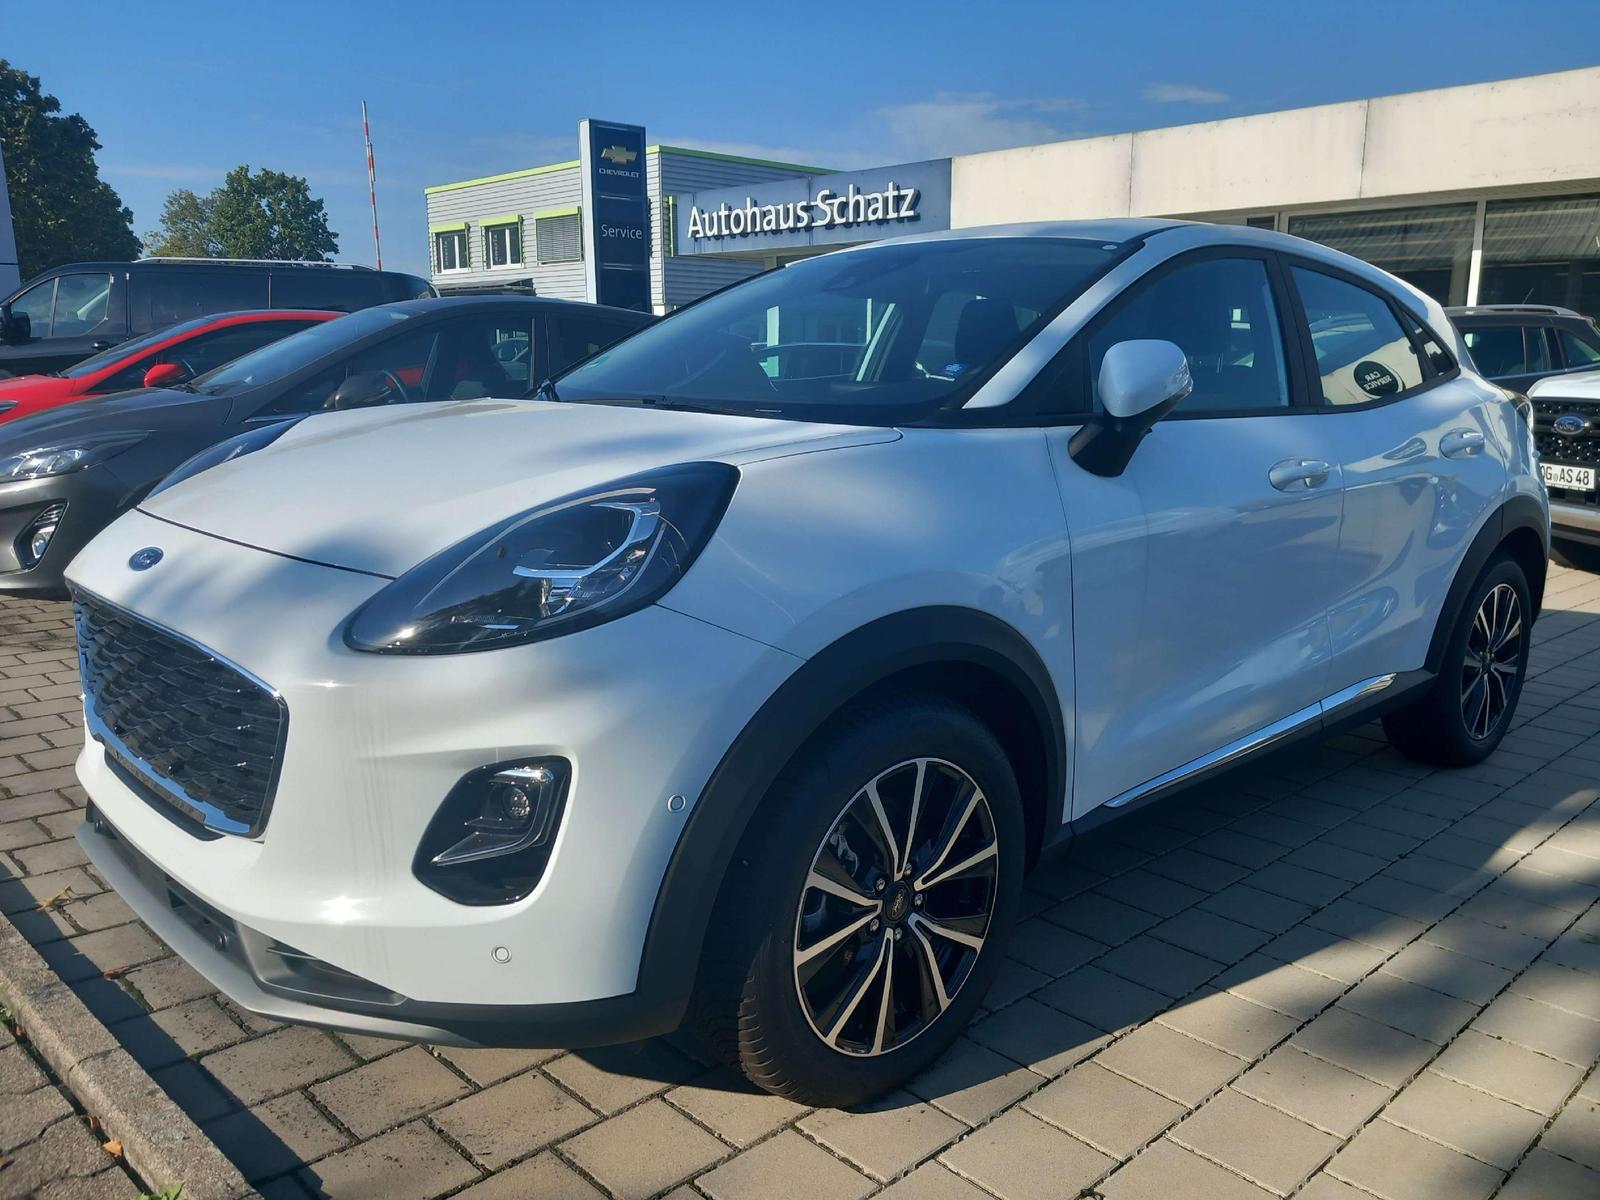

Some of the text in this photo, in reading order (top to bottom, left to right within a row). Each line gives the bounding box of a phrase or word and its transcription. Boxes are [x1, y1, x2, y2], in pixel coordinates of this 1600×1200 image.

[598, 167, 640, 178] CHEVROLET
[687, 180, 915, 239] Autohaus Schatz
[601, 223, 643, 239] Service
[1559, 467, 1574, 483] AS
[1575, 470, 1590, 486] 48
